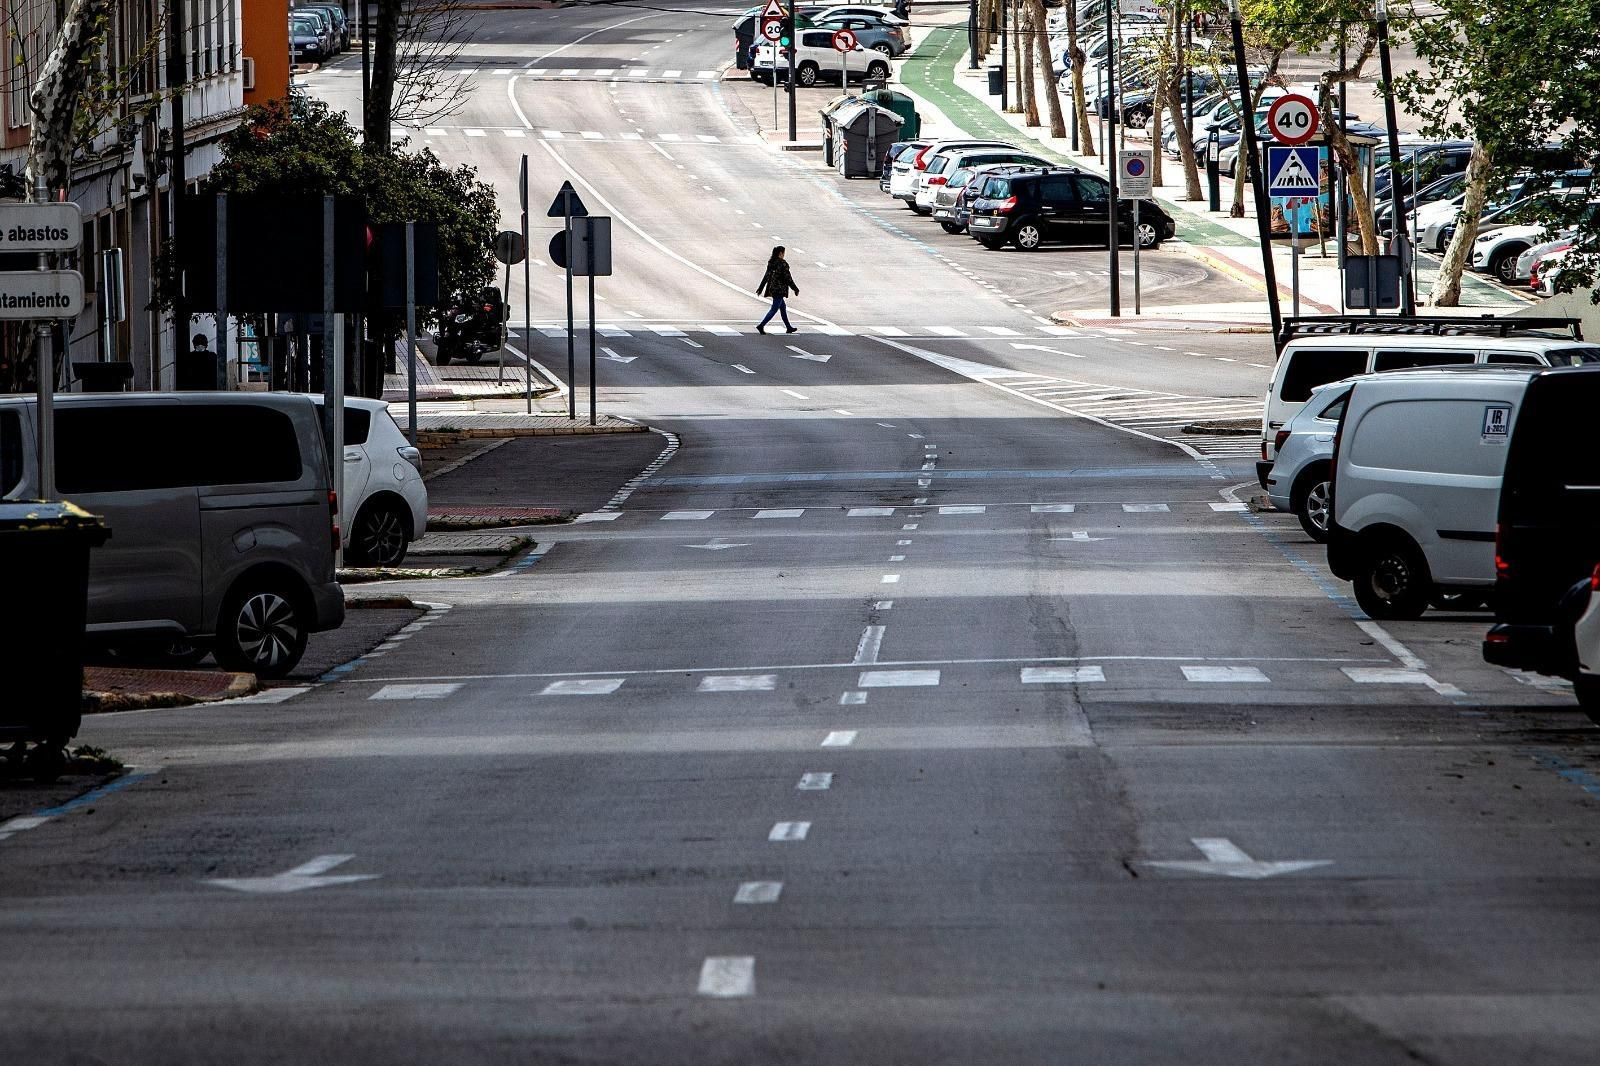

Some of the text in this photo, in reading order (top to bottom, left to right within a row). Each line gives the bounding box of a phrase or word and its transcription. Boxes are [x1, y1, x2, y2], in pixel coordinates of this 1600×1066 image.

[767, 25, 781, 34] 20
[1277, 111, 1309, 128] 40
[1212, 132, 1218, 140] P
[8, 225, 69, 241] abastos
[0, 291, 70, 308] tamiento
[1492, 410, 1503, 424] IR
